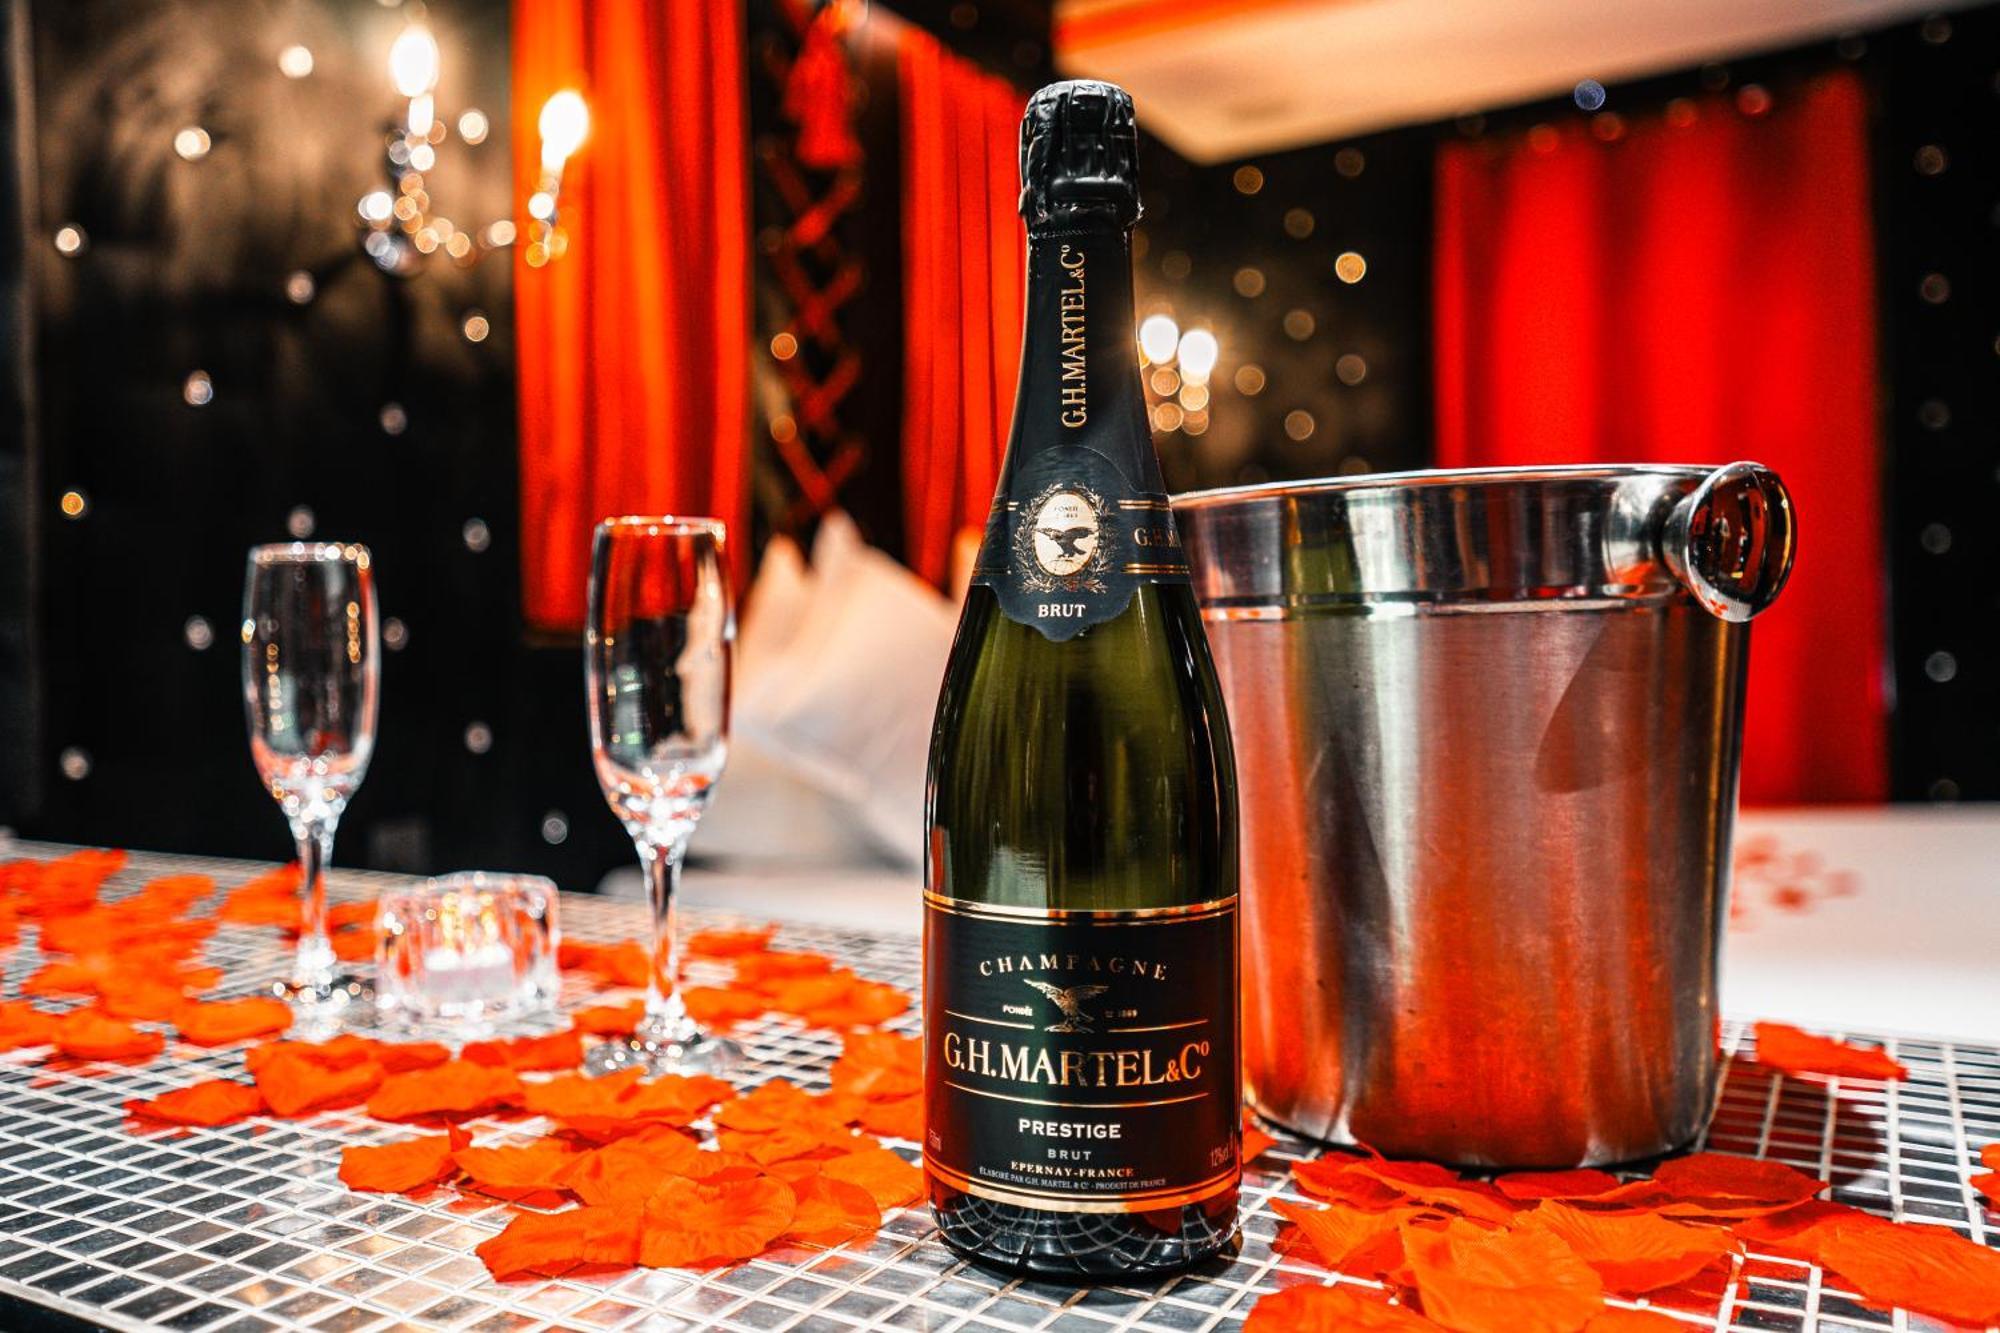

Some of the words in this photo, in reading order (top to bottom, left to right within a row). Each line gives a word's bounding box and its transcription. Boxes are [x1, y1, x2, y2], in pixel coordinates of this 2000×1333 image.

[1038, 604, 1086, 618] BRUT
[980, 953, 1168, 981] CHAMPAGNE
[1018, 1118, 1122, 1139] PRESTIGE
[1047, 1148, 1092, 1161] BRUT
[1041, 1178, 1072, 1189] MARTEL
